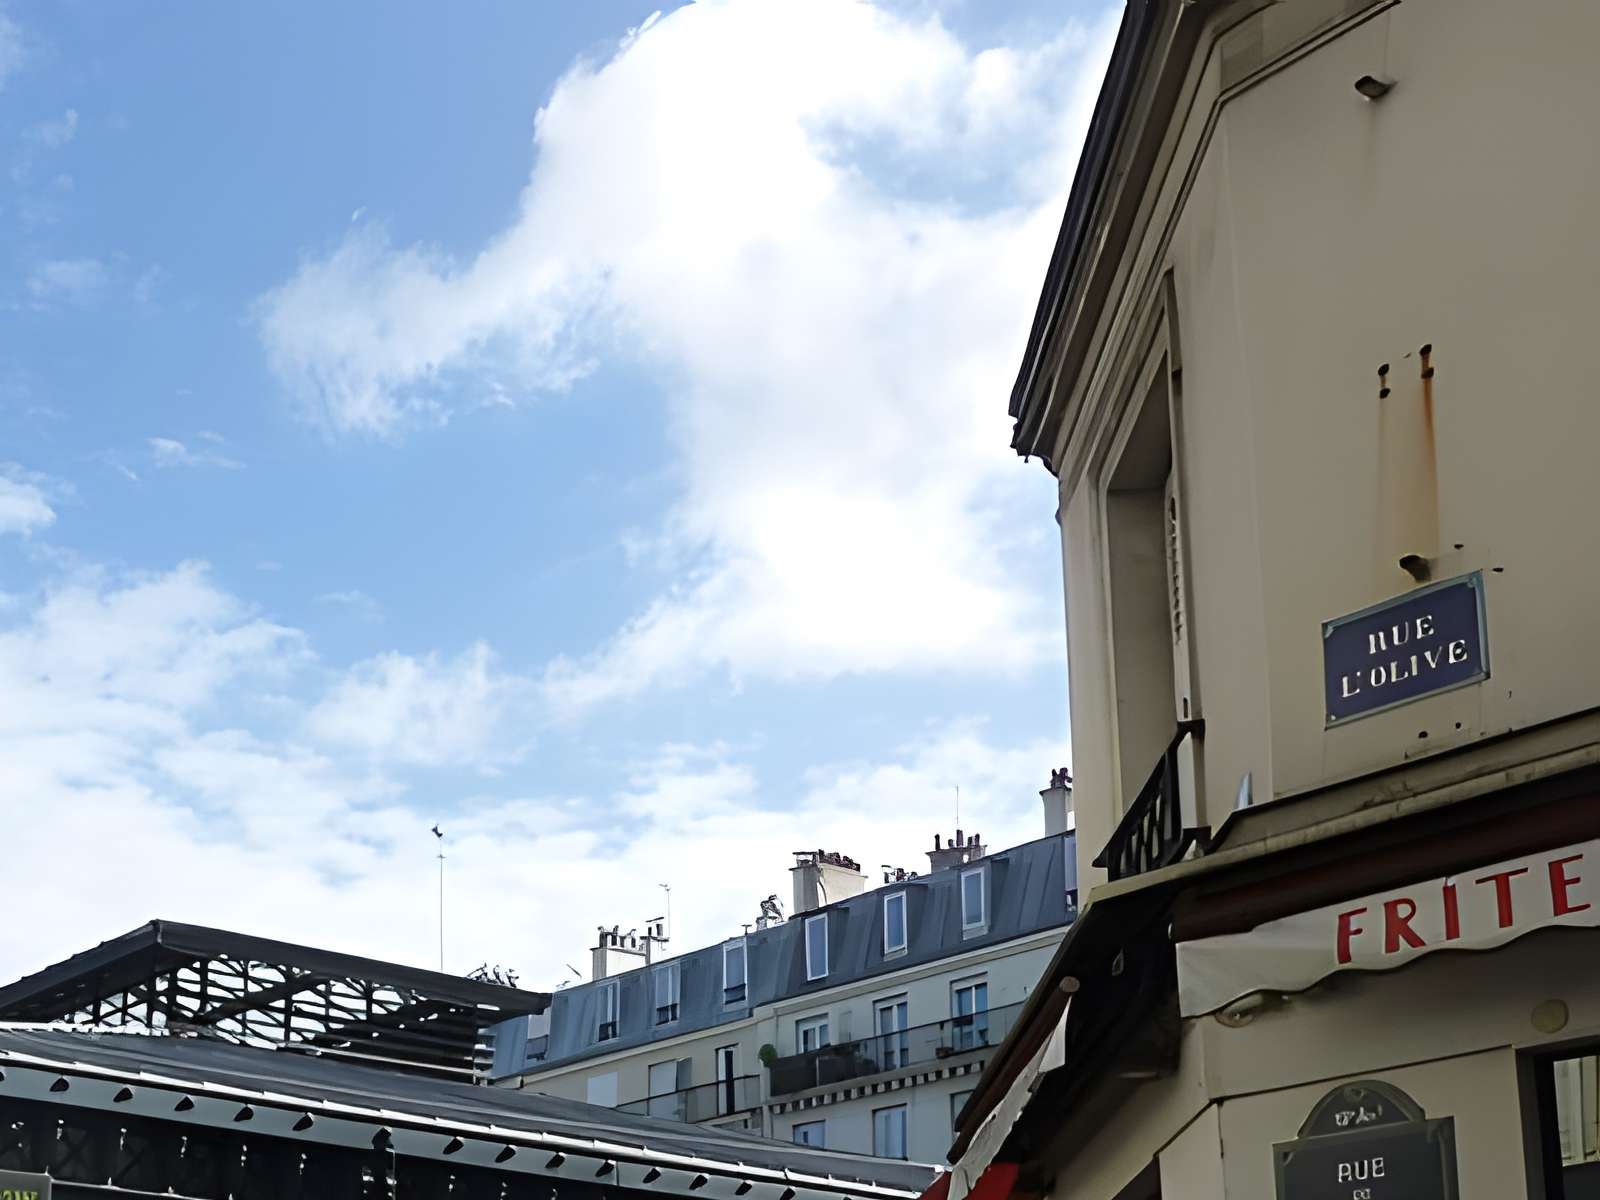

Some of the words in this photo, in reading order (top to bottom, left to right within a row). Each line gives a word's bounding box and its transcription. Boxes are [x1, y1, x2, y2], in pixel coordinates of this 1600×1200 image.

[1368, 614, 1435, 655] RUE
[1341, 639, 1469, 699] L'OLIVE
[1336, 853, 1592, 965] FRITE
[1337, 1156, 1385, 1184] RUE
